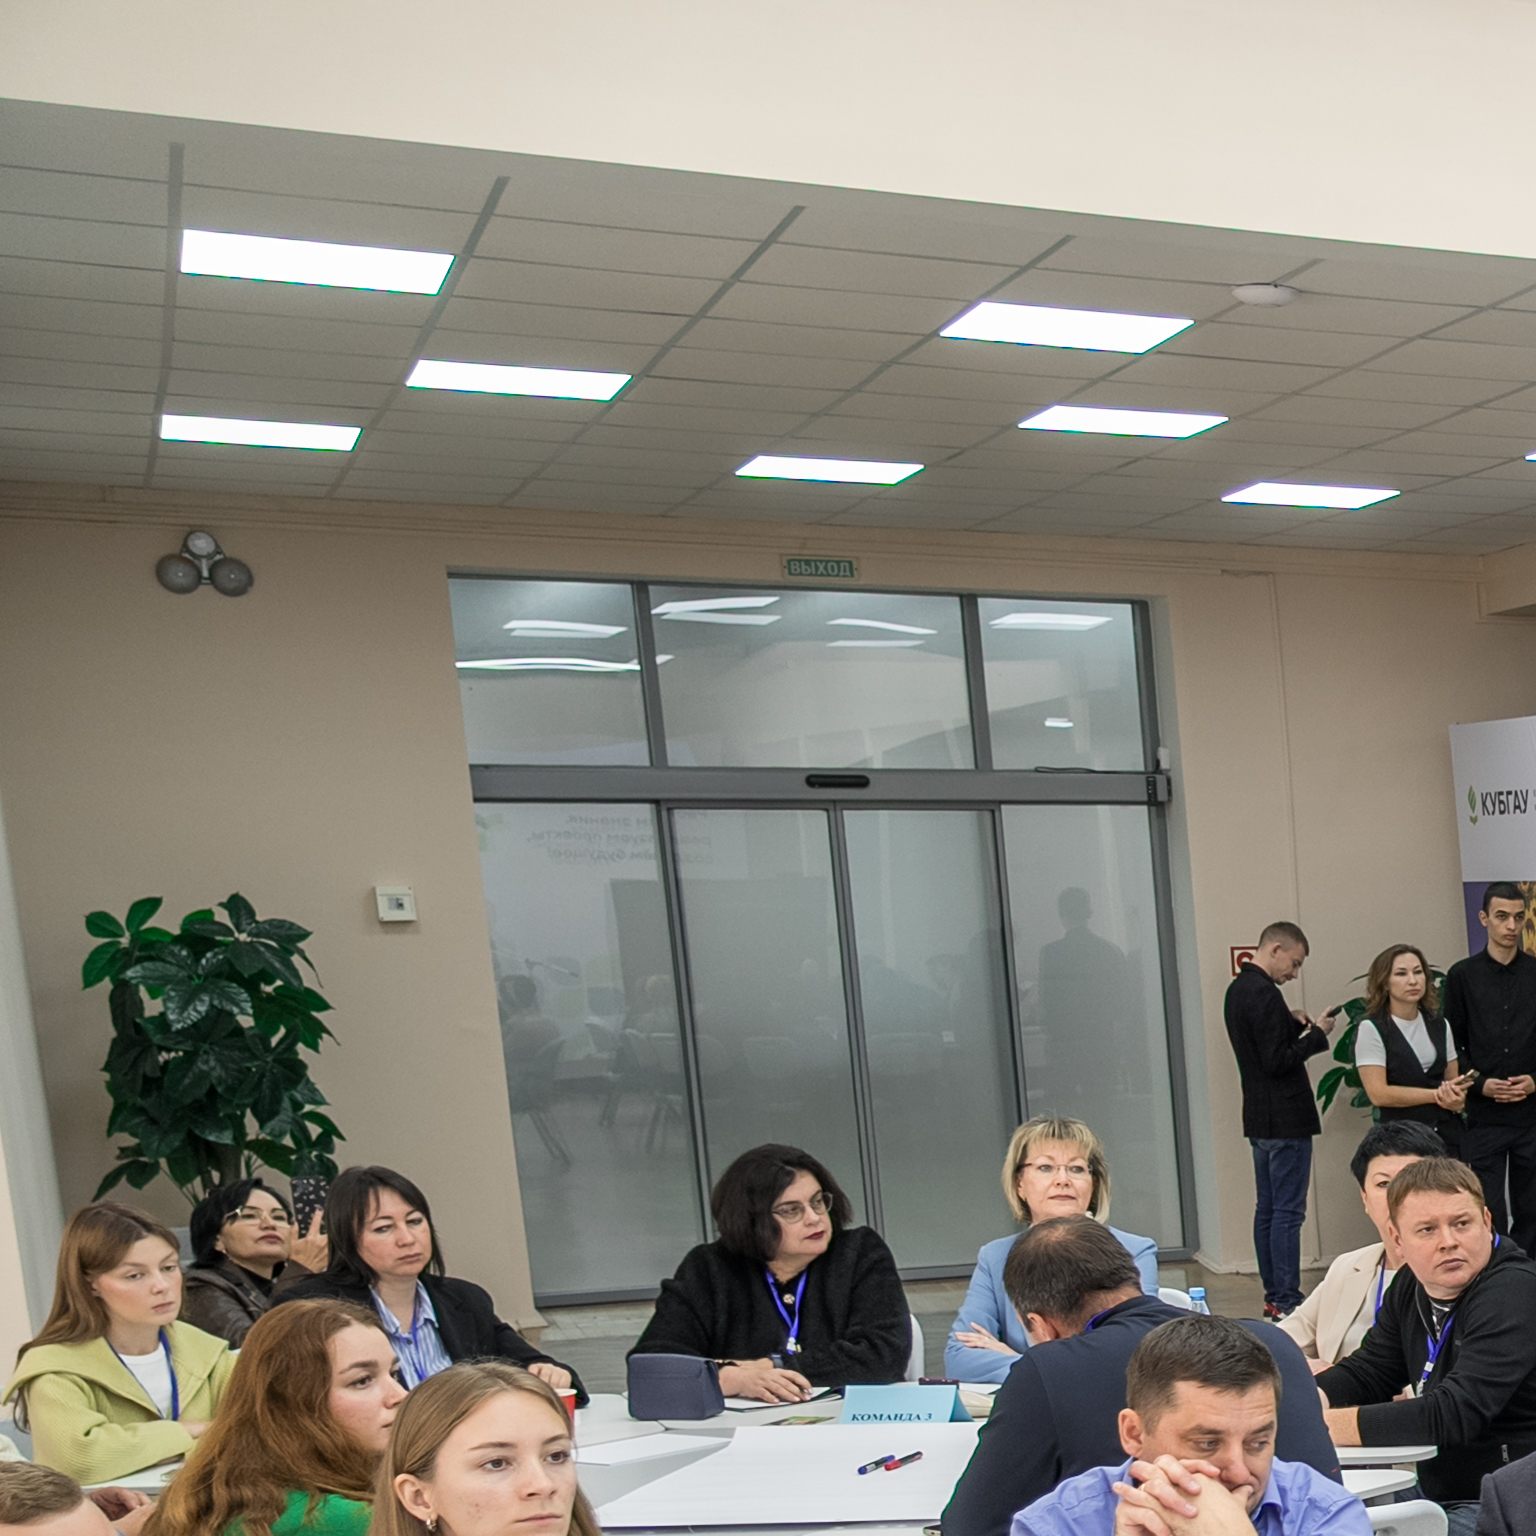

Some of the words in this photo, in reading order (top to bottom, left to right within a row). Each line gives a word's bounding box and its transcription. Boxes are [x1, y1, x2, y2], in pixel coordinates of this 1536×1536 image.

[789, 560, 851, 577] ВЫХОД
[1480, 789, 1529, 816] КУБГАУ
[851, 1413, 921, 1422] КОМАНДА
